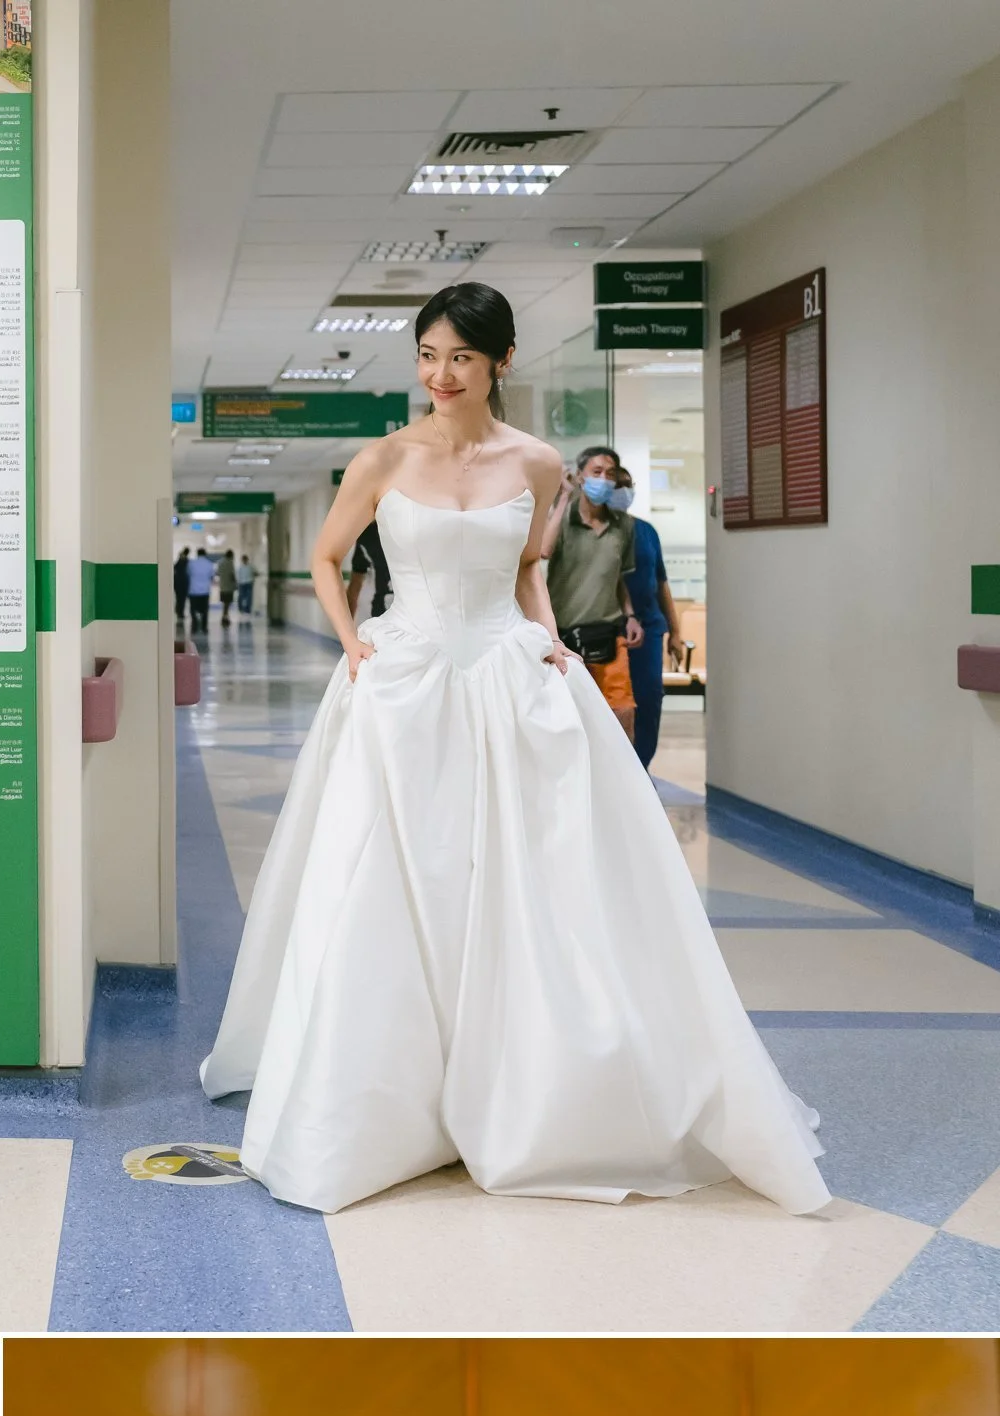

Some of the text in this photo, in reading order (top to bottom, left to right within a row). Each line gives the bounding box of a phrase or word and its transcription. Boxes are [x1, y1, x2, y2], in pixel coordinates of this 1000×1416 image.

[623, 270, 685, 282] Occupational
[632, 283, 669, 296] Therapy
[803, 273, 822, 320] B1
[613, 323, 688, 336] Speech Therapy
